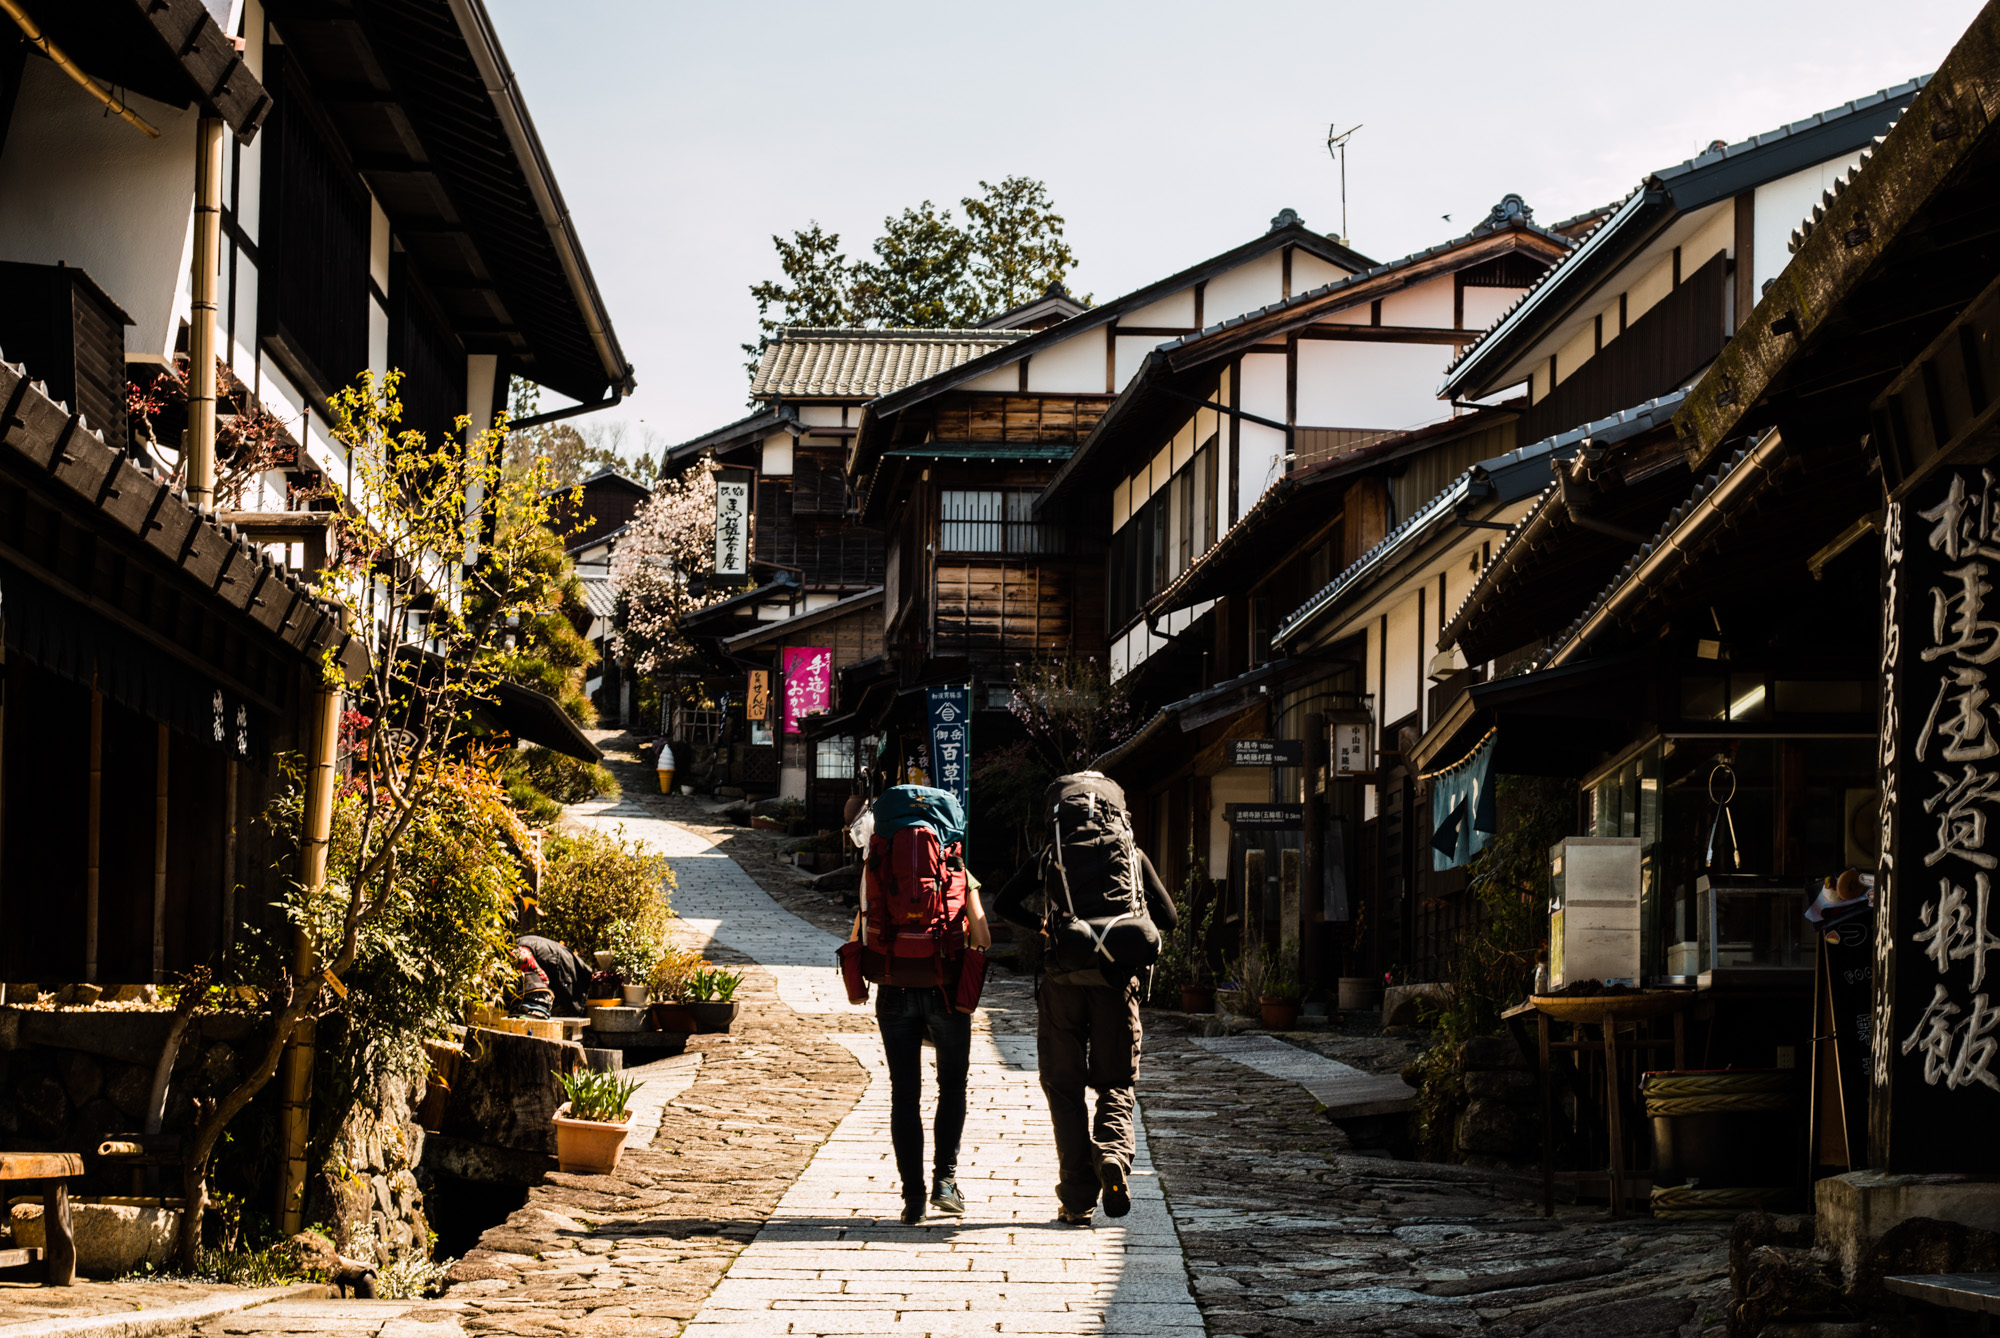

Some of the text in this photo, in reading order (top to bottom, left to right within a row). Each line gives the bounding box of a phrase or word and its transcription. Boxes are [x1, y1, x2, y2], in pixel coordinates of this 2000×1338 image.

[718, 498, 743, 571] 馬籠茶屋
[806, 653, 826, 705] 手造り
[1351, 726, 1360, 754] 中山道
